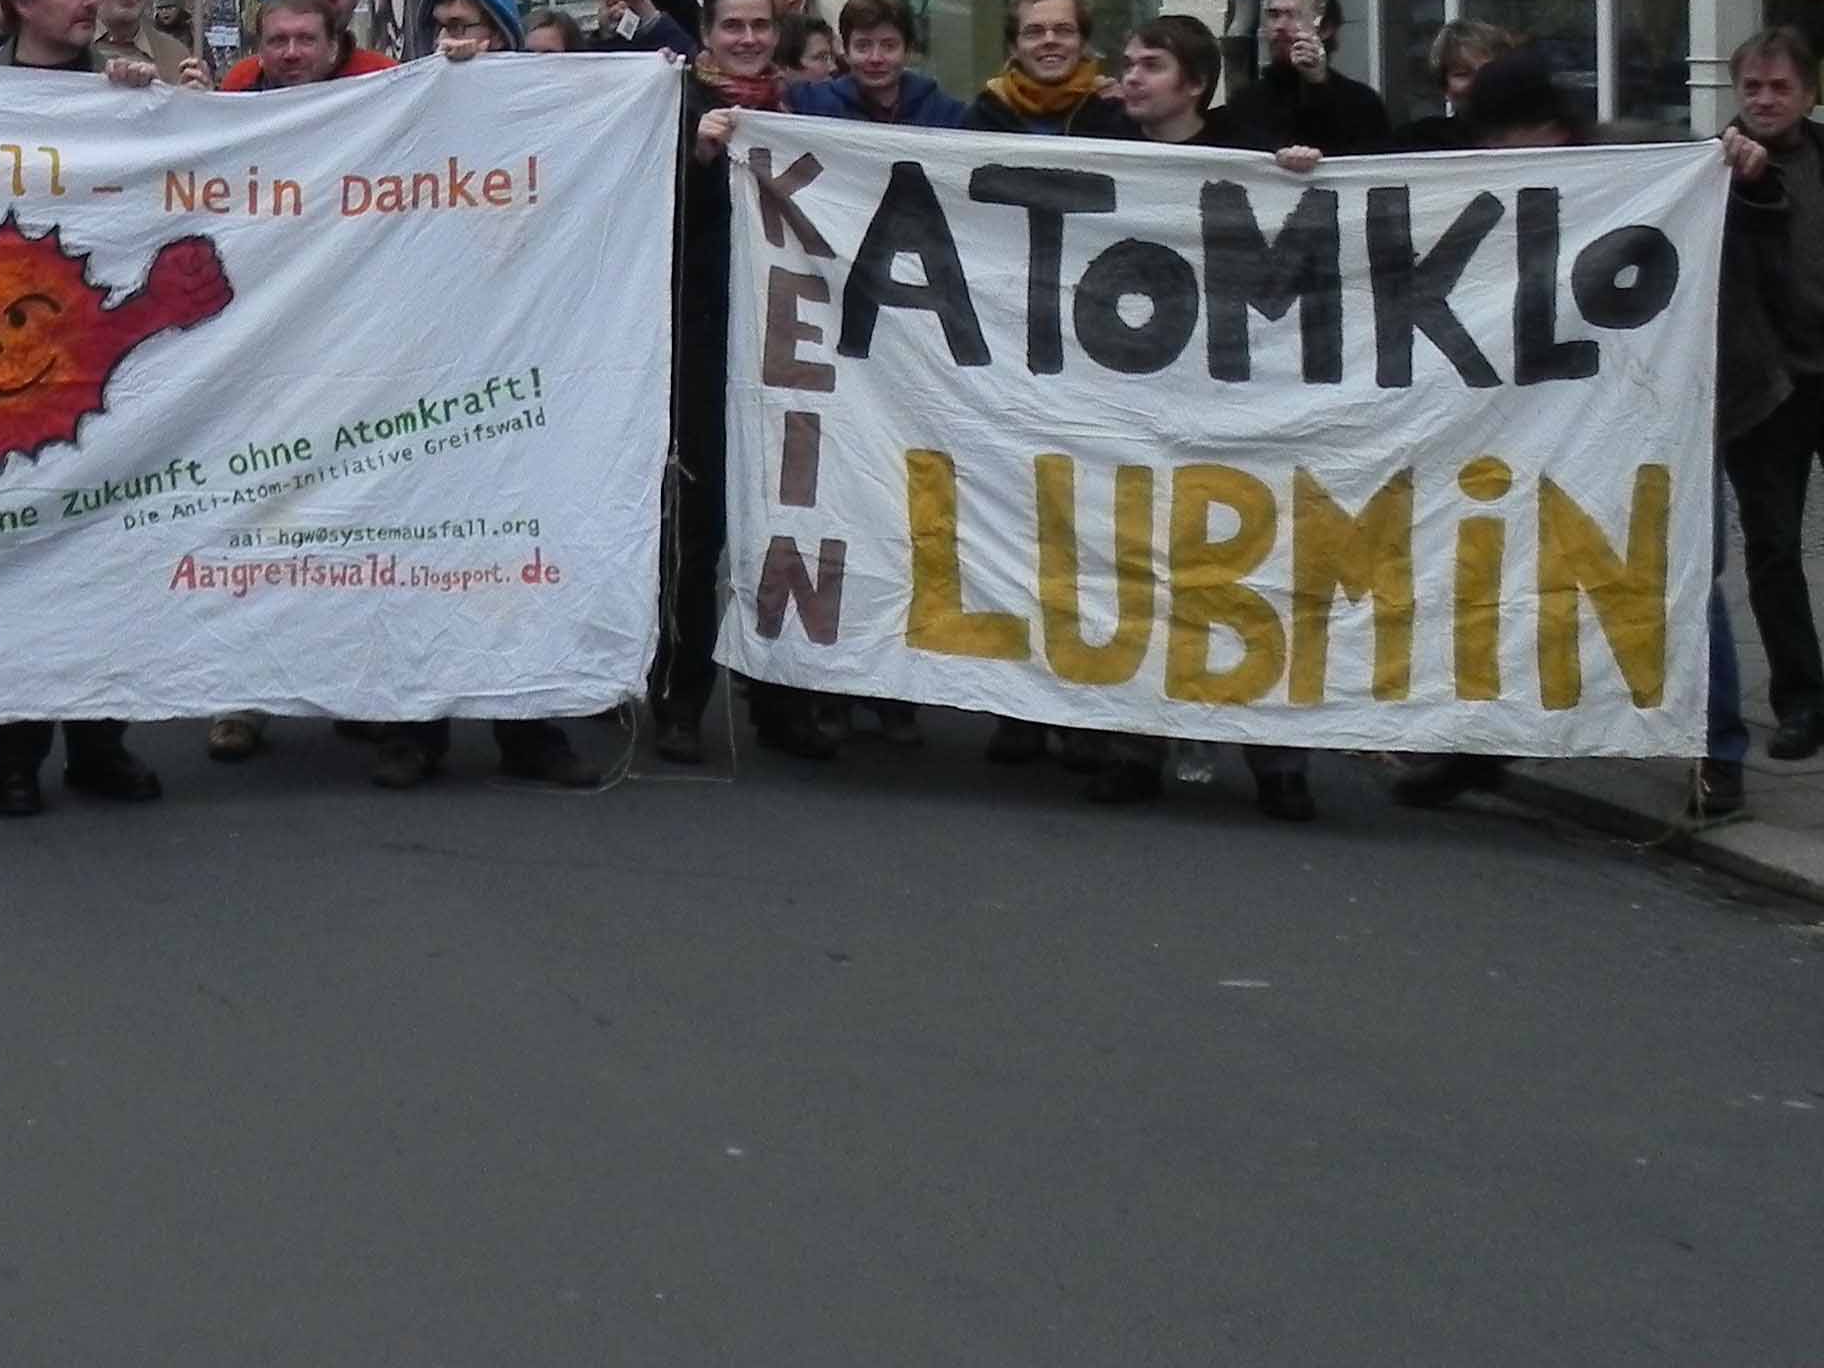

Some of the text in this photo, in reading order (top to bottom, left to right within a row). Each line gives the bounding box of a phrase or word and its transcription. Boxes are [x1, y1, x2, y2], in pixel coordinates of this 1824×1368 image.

[162, 167, 303, 217] Nein
[340, 154, 540, 218] Danke!
[61, 457, 207, 519] Zukunft
[228, 436, 314, 476] ohne
[333, 367, 543, 452] Atomkraft!
[747, 145, 848, 646] KEIN
[123, 508, 161, 531] Die
[423, 406, 547, 456] Greifswald
